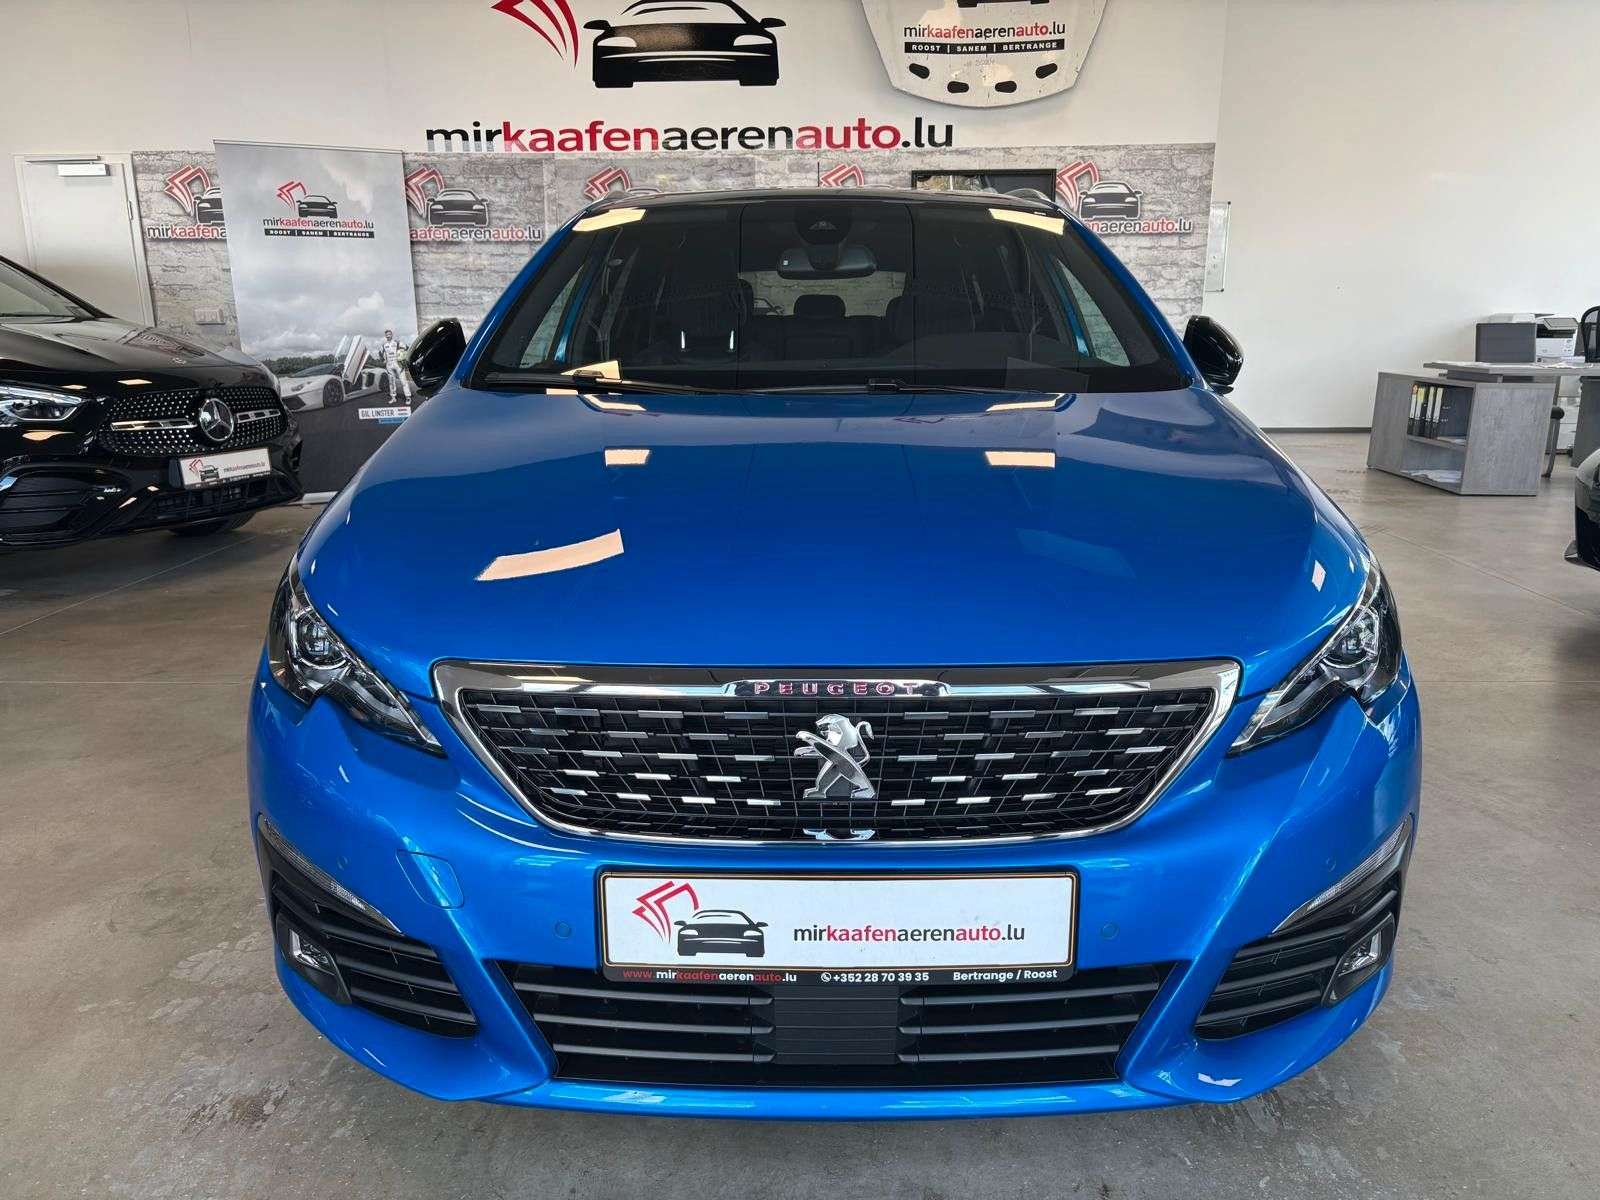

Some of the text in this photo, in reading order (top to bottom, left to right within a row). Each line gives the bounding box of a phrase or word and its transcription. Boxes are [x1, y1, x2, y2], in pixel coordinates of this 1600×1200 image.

[904, 21, 1066, 39] mirkaafenaerenauto.lu
[911, 43, 941, 52] ROOST
[1002, 41, 1058, 51] BERTRANGE
[426, 117, 954, 152] mirkaafenaerenauto.lu
[263, 216, 374, 229] mirkaafenaerenauto.lu
[754, 681, 919, 696] PEUGEOT
[793, 923, 1026, 943] mirkaafenaerenauto.lu
[833, 972, 929, 983] +352 28 70 39 35
[953, 971, 1014, 983] Bertrange
[1024, 969, 1058, 979] Roost
